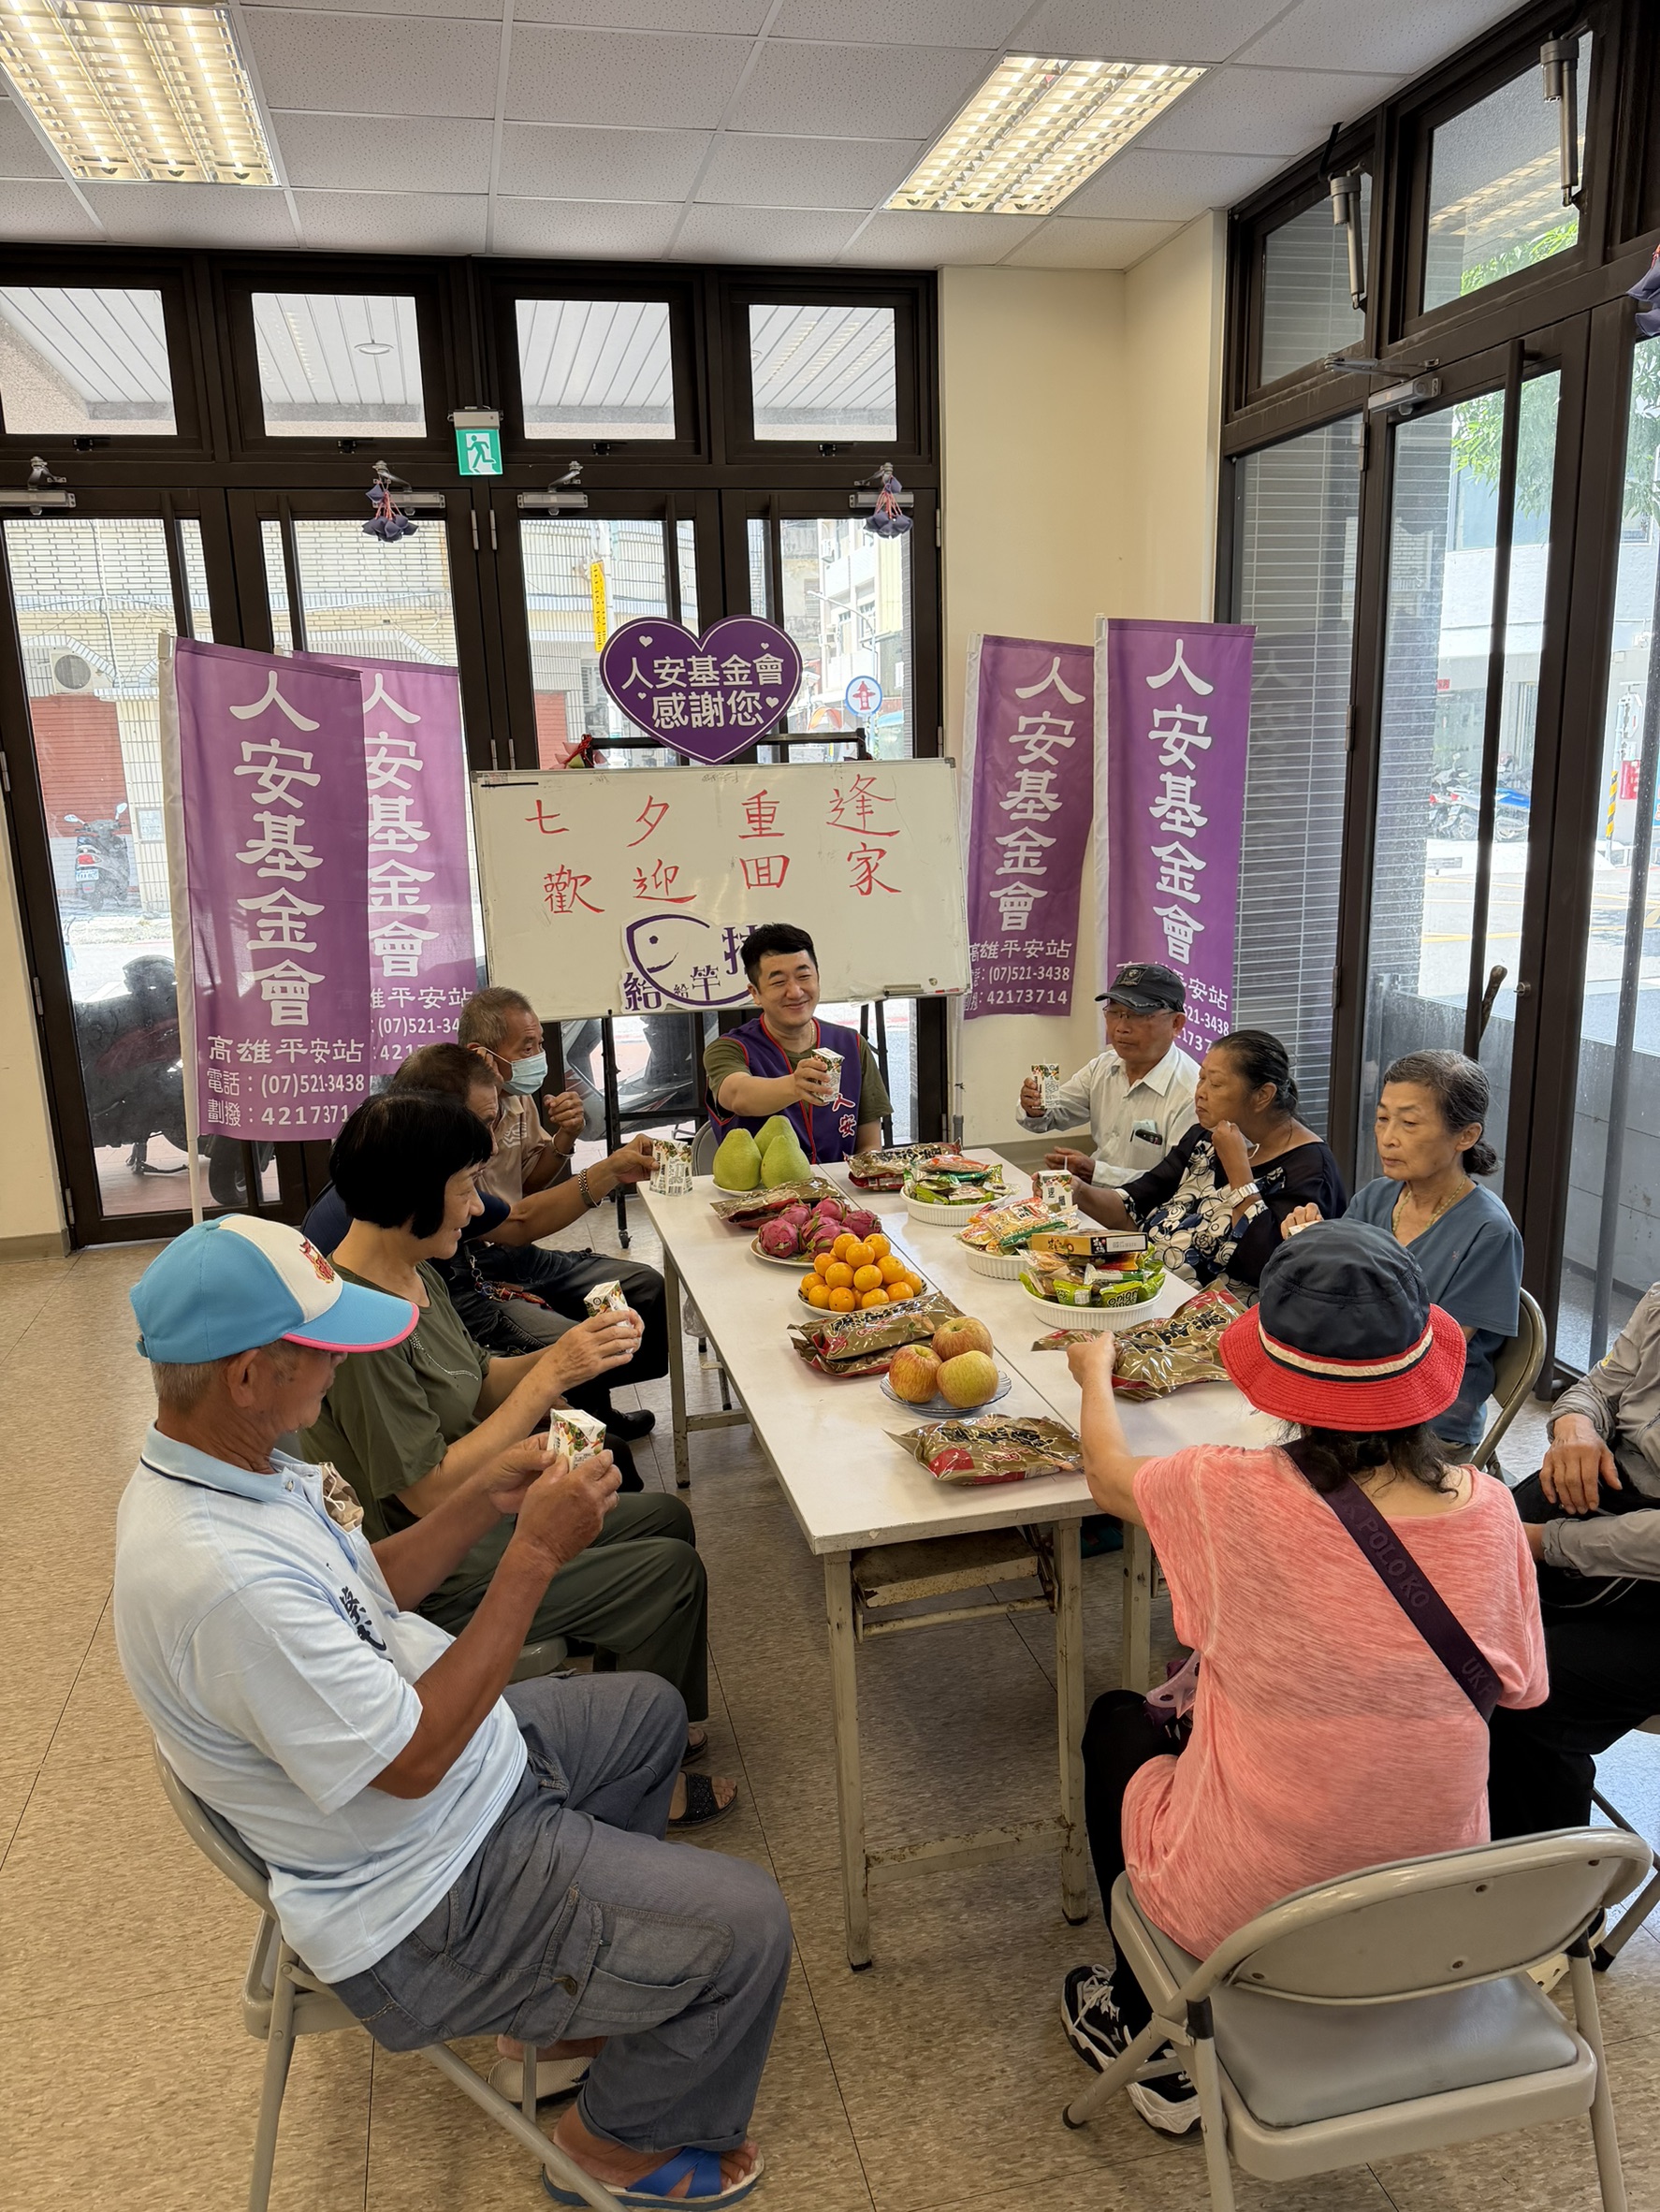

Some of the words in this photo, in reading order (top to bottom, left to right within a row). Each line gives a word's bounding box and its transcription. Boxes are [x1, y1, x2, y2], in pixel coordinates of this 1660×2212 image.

[620, 652, 785, 691] 人安基金會
[651, 690, 765, 730] 感謝您
[228, 670, 326, 1027] 人安基金會
[362, 673, 441, 978] 人安基金會
[989, 656, 1086, 932] 人安基金會
[1145, 638, 1215, 966] 人安基金會
[968, 939, 1072, 962] 高雄平安站
[207, 1035, 365, 1064] 高雄平安站
